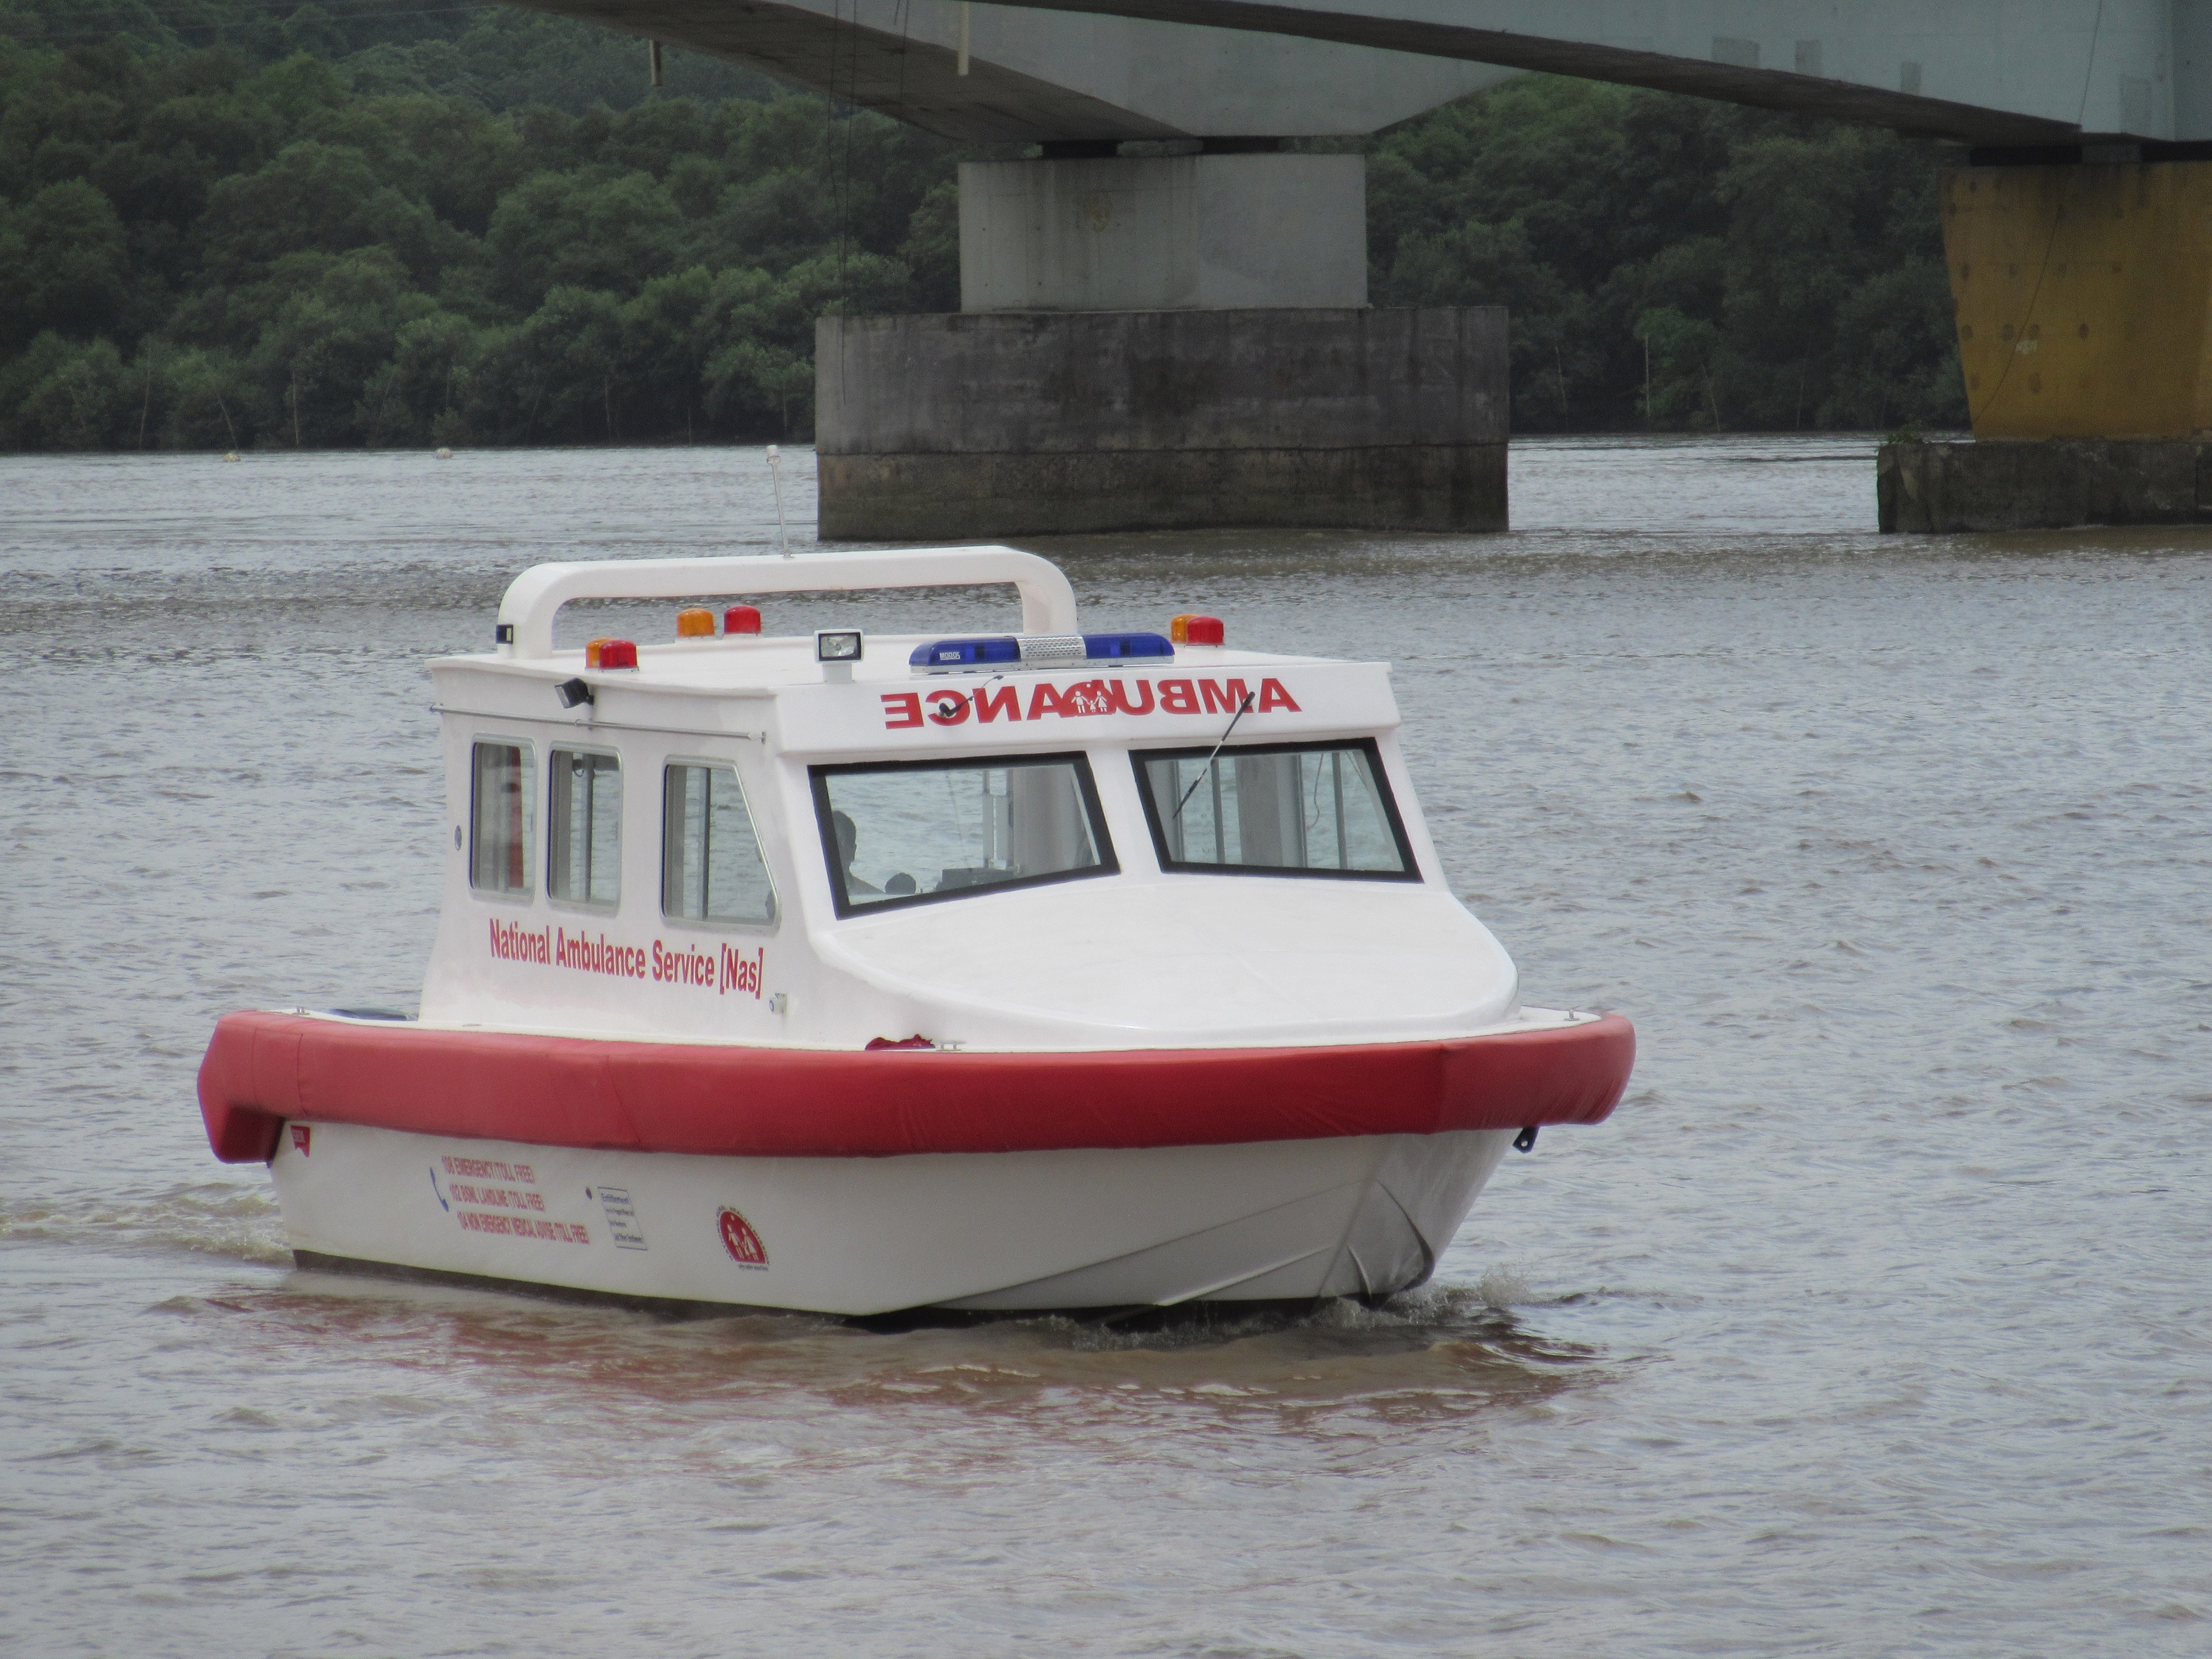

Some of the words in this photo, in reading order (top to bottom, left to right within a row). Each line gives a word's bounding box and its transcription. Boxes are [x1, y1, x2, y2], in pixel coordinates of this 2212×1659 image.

[489, 918, 551, 965] National
[556, 926, 646, 979] Ambulance
[652, 939, 715, 987] Service
[719, 942, 764, 1000] [Nas]
